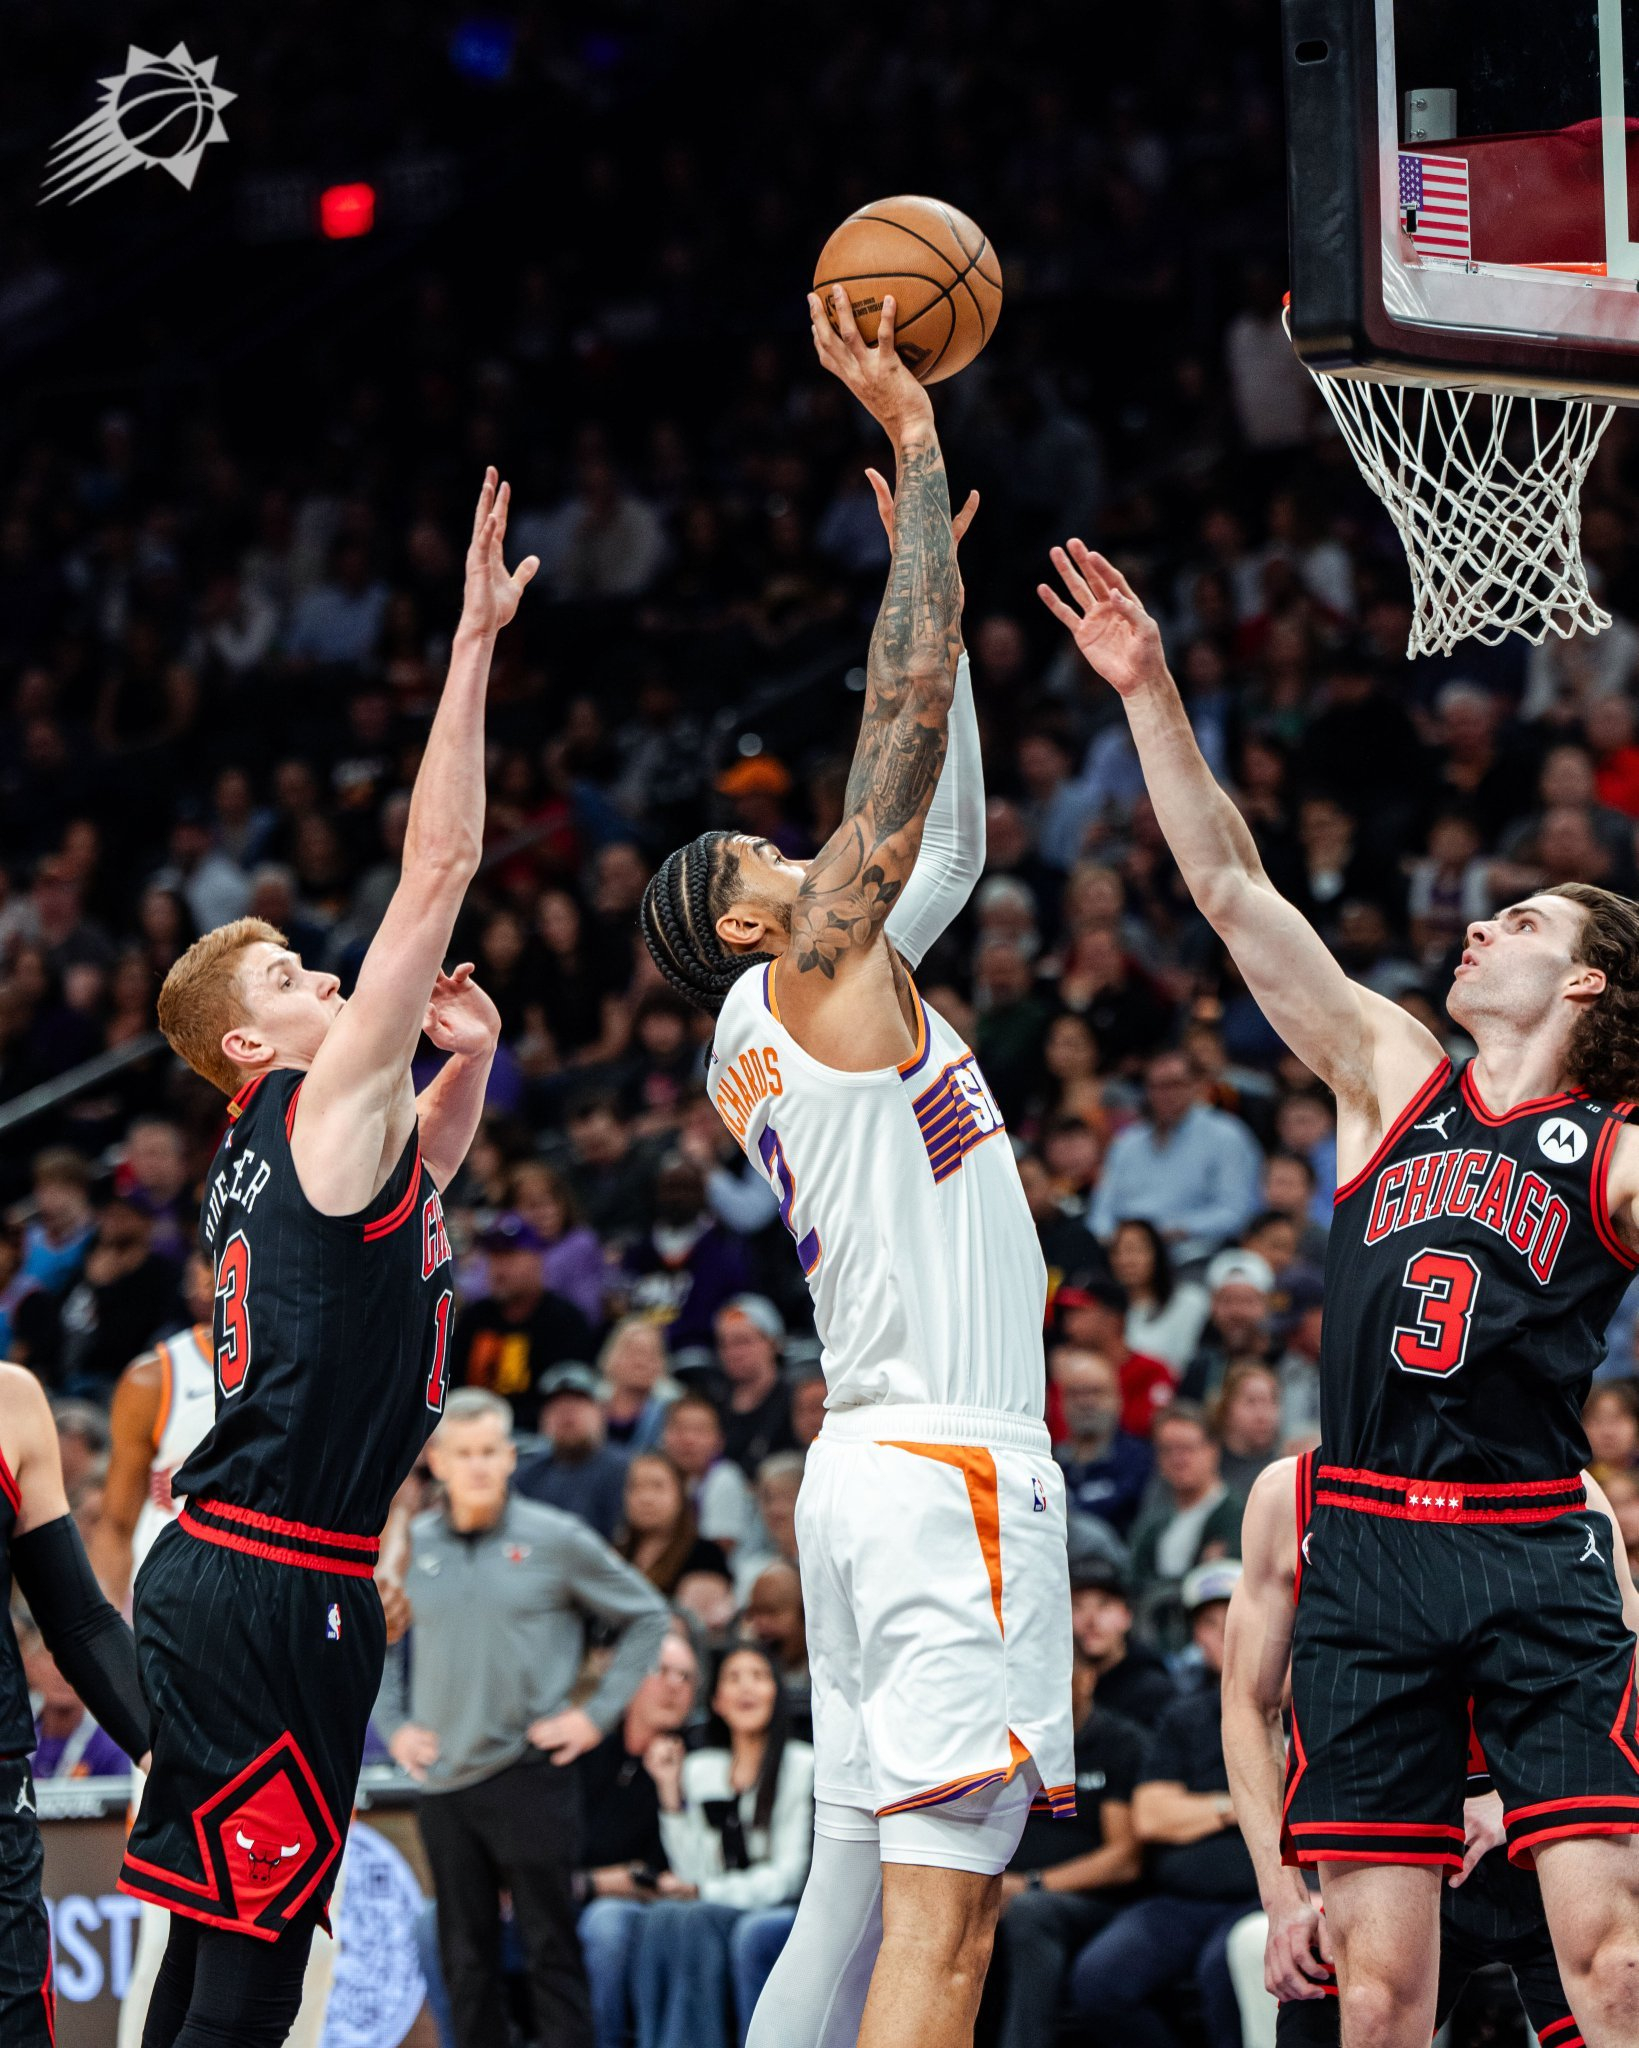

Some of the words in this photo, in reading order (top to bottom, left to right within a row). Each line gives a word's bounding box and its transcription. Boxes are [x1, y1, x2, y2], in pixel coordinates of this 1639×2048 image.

[716, 1047, 783, 1152] ICHARDS
[1363, 1148, 1571, 1286] CHICAGO
[214, 1229, 252, 1399] 3
[426, 1289, 456, 1414] 1
[1390, 1247, 1481, 1379] 3
